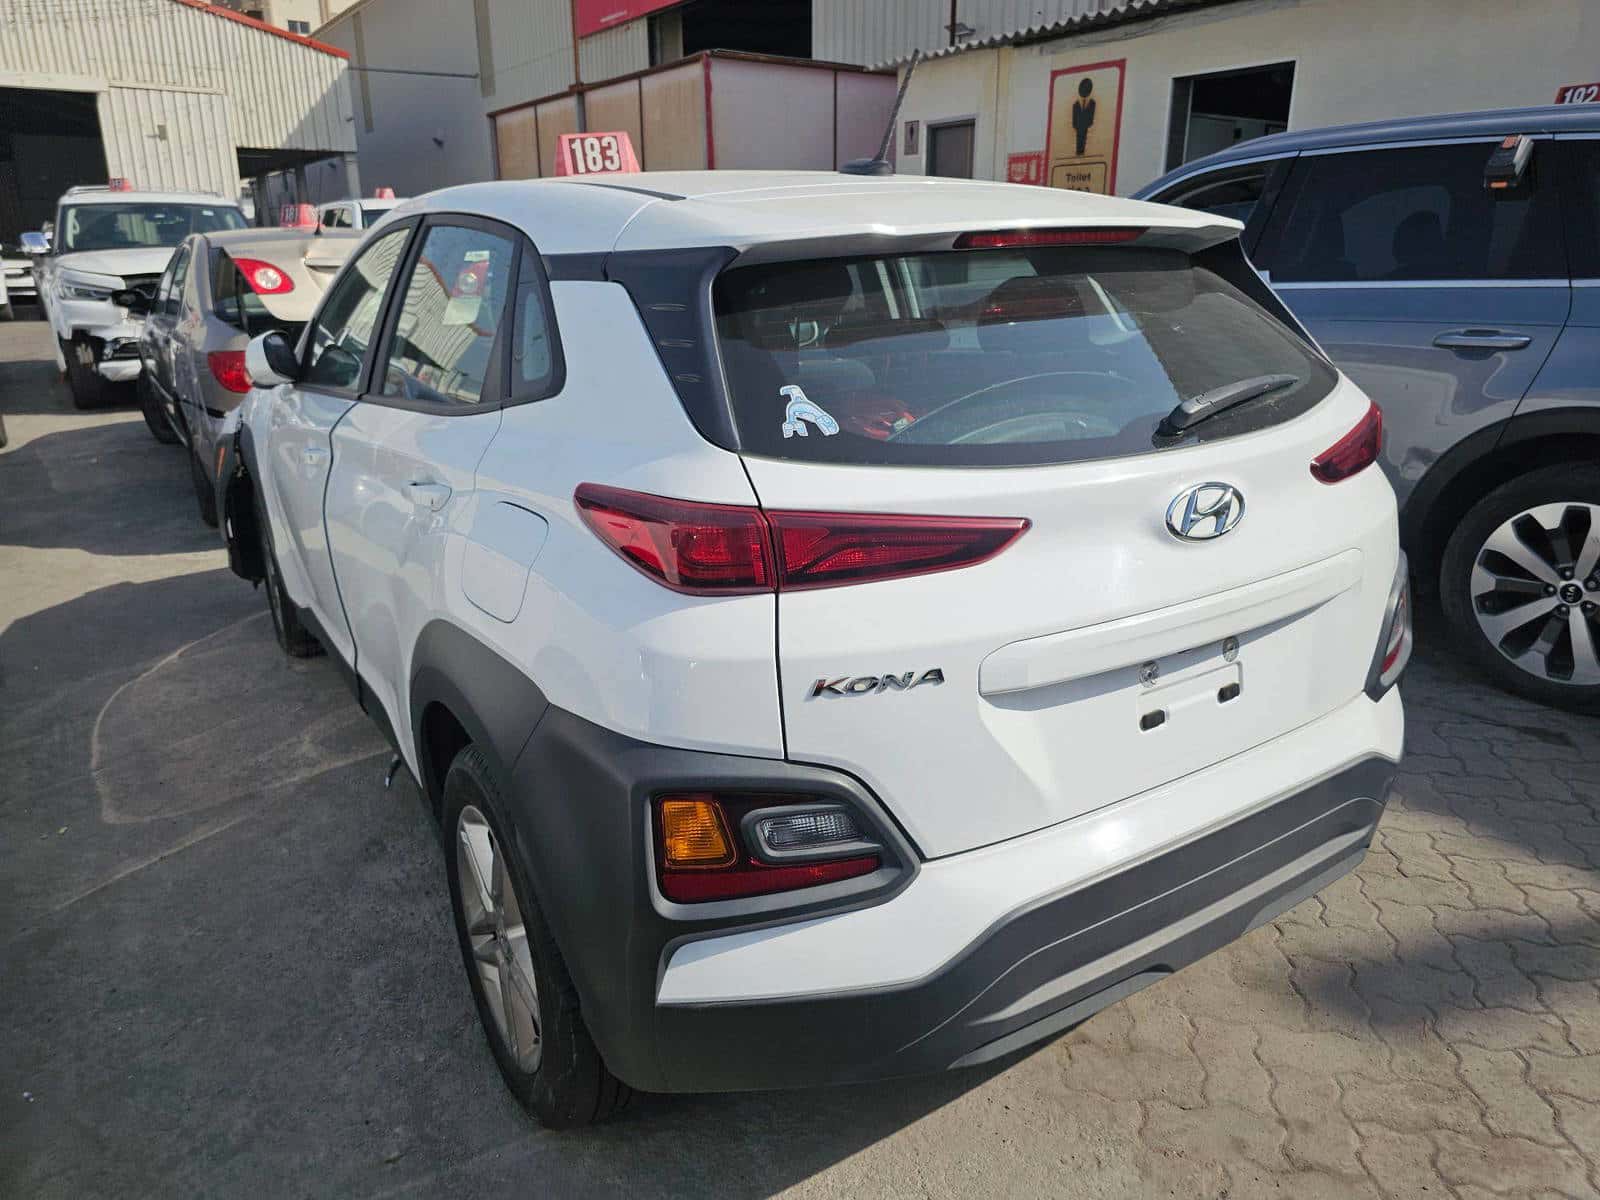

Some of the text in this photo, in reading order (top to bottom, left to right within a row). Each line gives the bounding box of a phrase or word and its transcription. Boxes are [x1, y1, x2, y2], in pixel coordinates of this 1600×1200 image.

[570, 136, 620, 173] 183
[1065, 172, 1091, 183] Toilet
[811, 668, 945, 697] KONA
